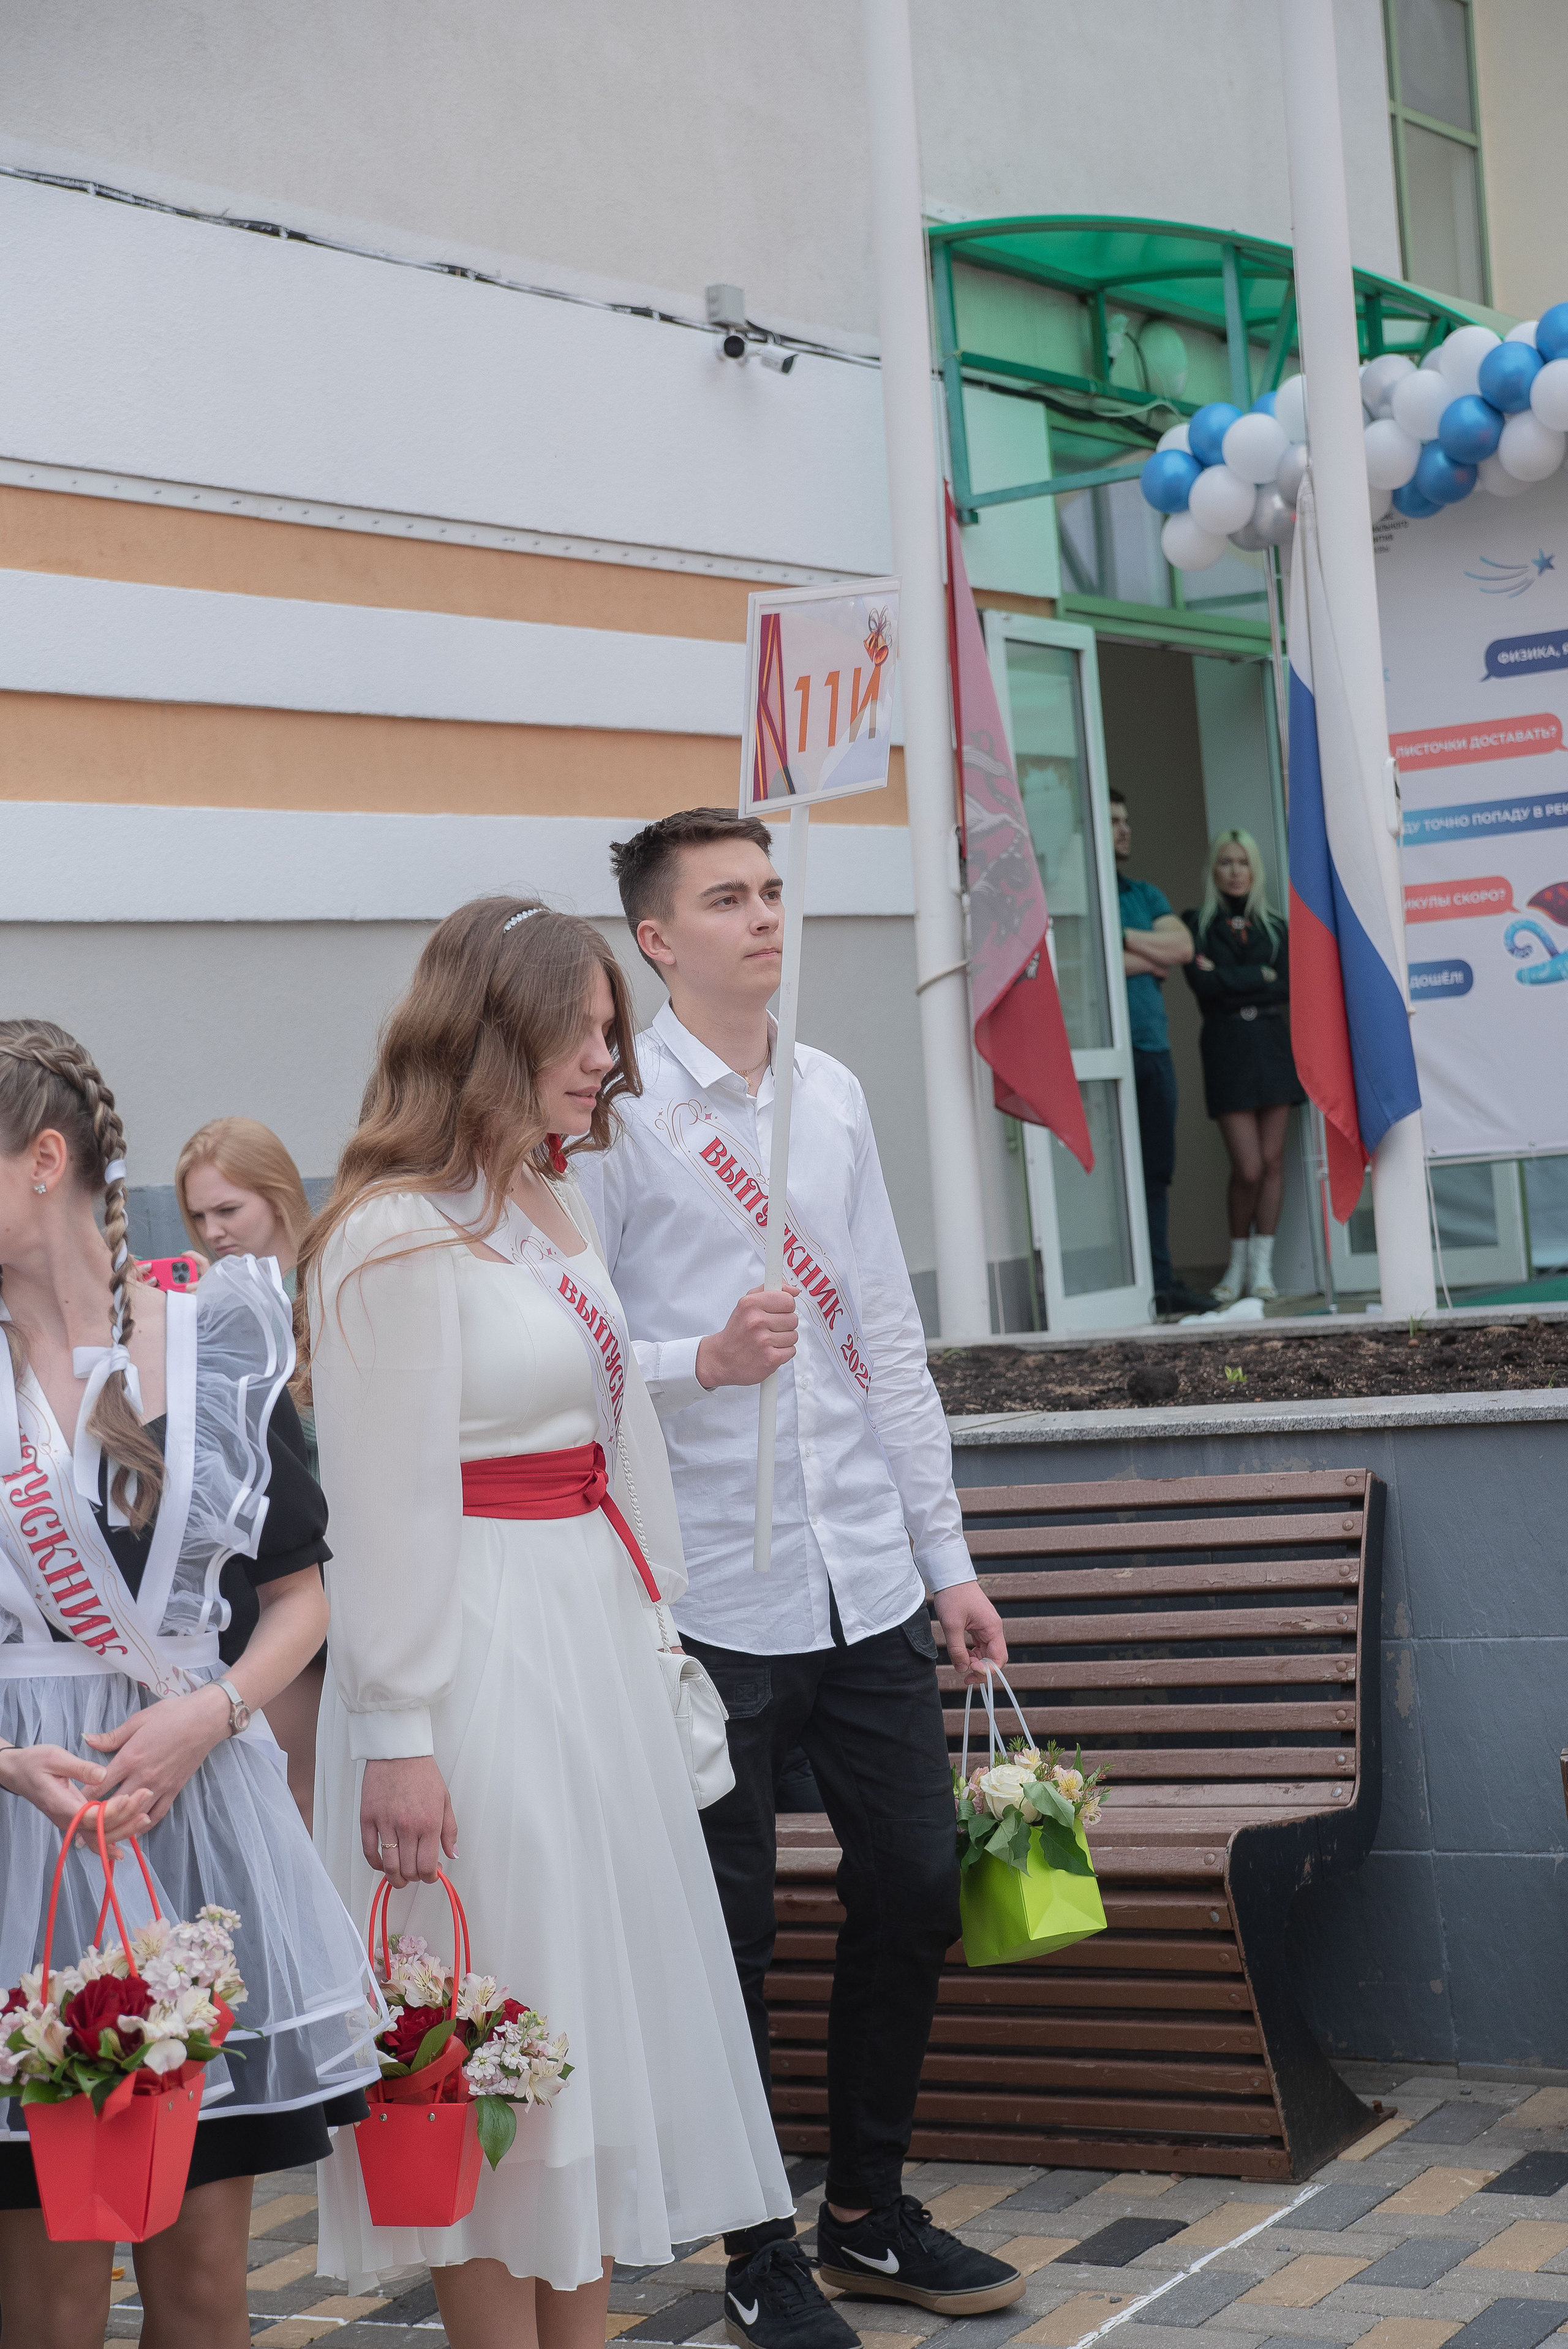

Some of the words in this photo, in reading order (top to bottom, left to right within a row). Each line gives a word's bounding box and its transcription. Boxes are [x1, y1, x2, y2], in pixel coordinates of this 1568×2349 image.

[1498, 644, 1561, 665] ФИЗИКА,
[794, 666, 881, 754] 11И
[1395, 738, 1468, 758] ЛИСТОЧКИ
[1469, 725, 1558, 750] ДОСТАВАТЬ?
[1423, 814, 1470, 831] ТОЧНО
[1471, 807, 1531, 826] ПОПАДУ
[1532, 804, 1544, 819] В
[1453, 888, 1506, 906] СКОРО?
[698, 1136, 843, 1330] ВЫПКНИК
[840, 1333, 871, 1399] 202
